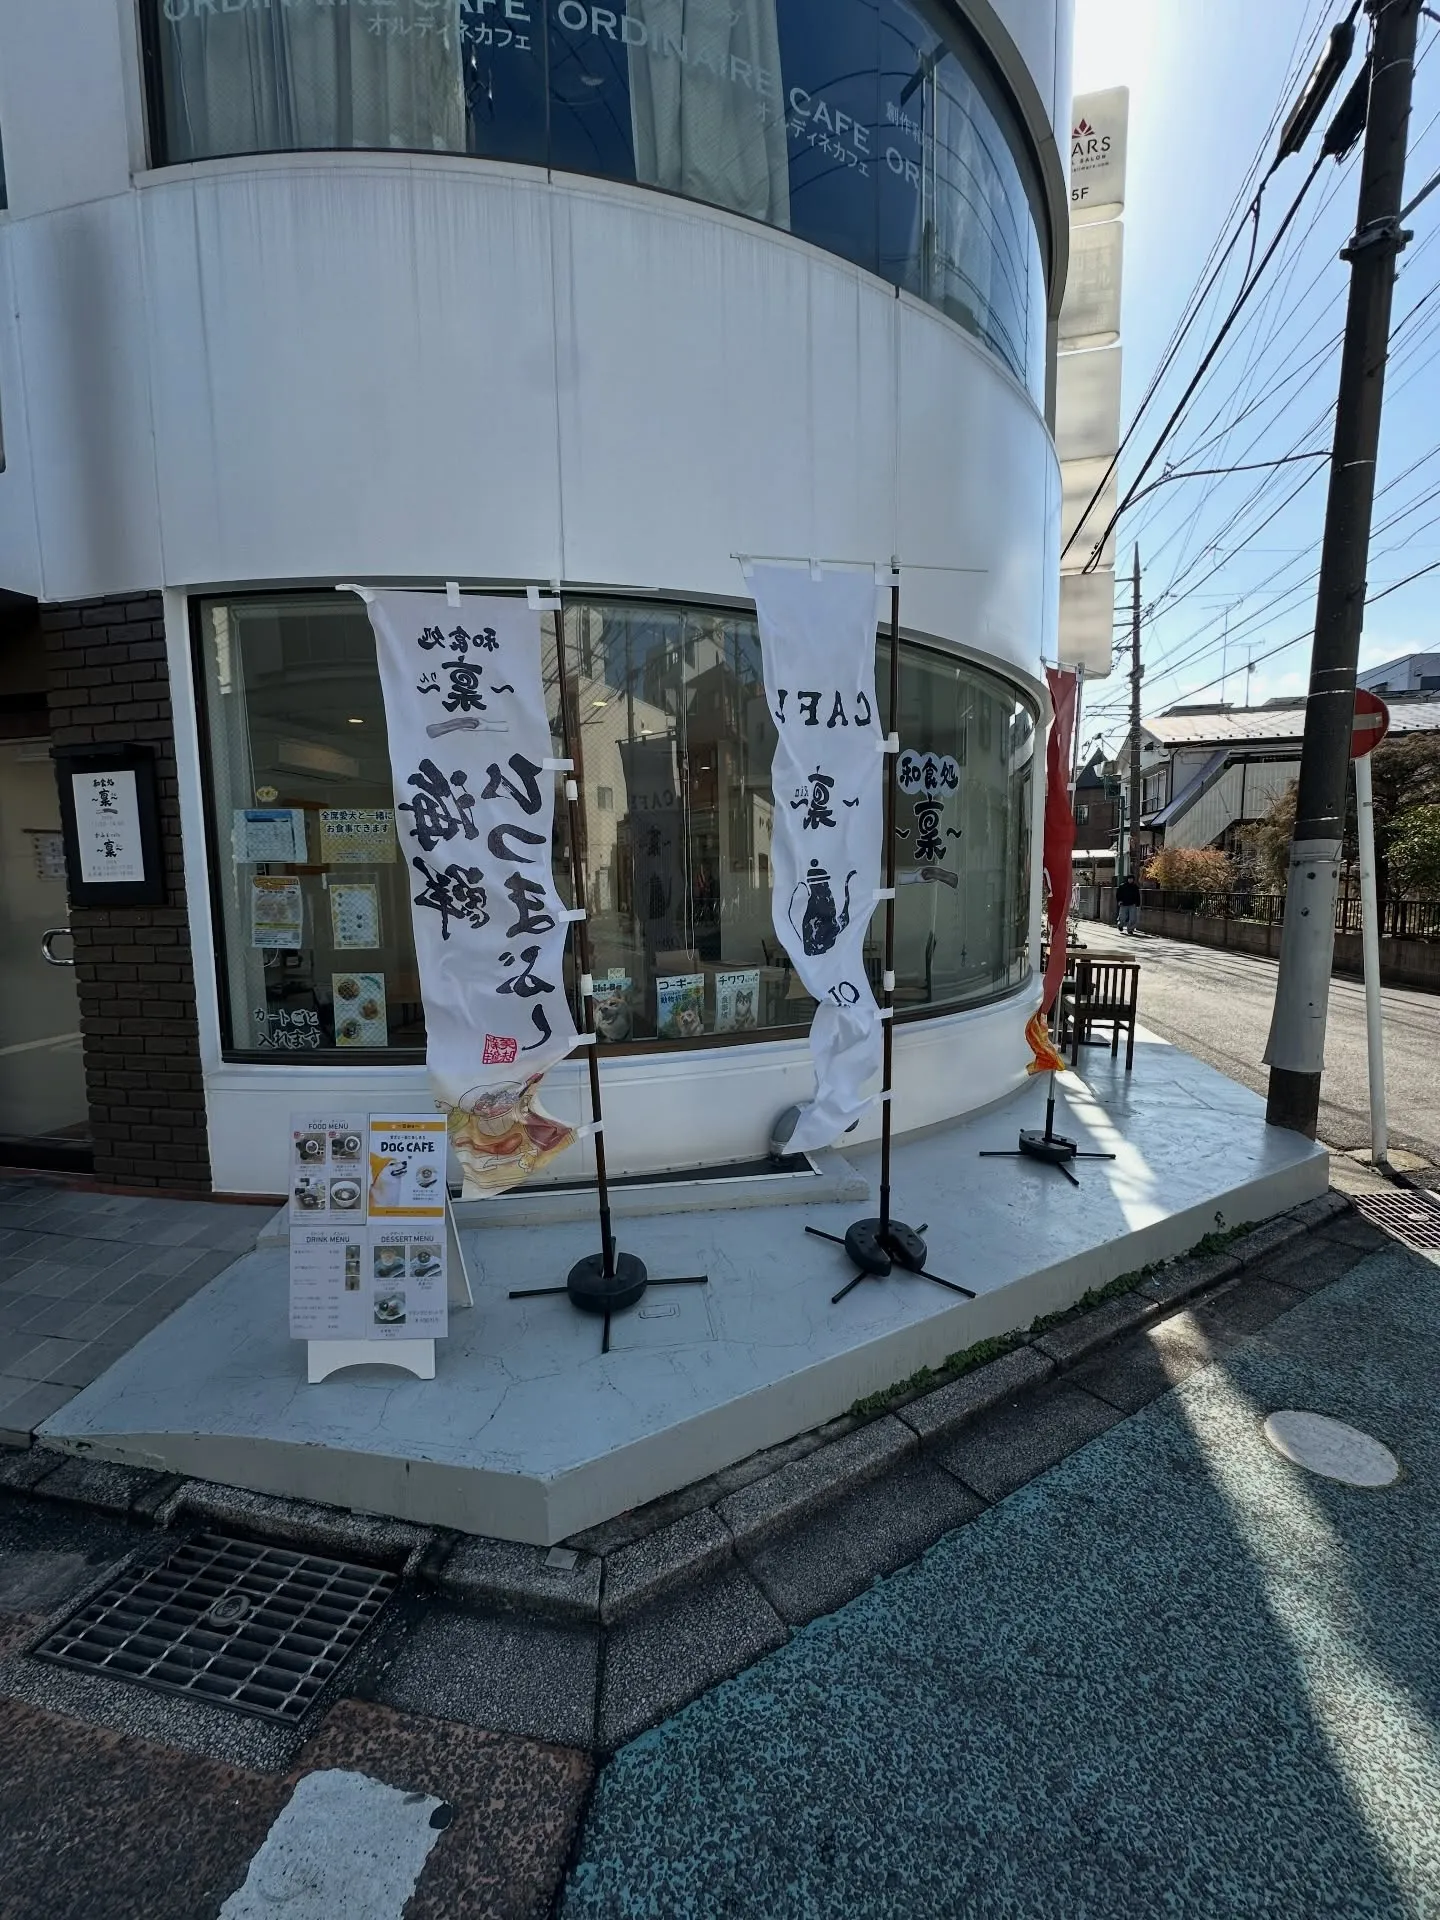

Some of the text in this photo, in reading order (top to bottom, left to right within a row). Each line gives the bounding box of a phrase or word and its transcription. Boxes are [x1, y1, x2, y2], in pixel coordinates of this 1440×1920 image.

[789, 87, 870, 155] CAFE
[753, 100, 870, 178] オディネカフェ
[1071, 186, 1089, 201] 5F
[899, 756, 960, 790] 和食処
[326, 823, 389, 834] お食事できます
[658, 977, 693, 990] コーギー
[718, 974, 745, 986] チワワ
[254, 1008, 319, 1027] カートごと
[257, 1027, 321, 1049] 入れます
[328, 1122, 349, 1130] MENU
[380, 1141, 435, 1153] DOG CAFE
[329, 1235, 350, 1243] MENU
[380, 1234, 434, 1243] DESSERT MENU
